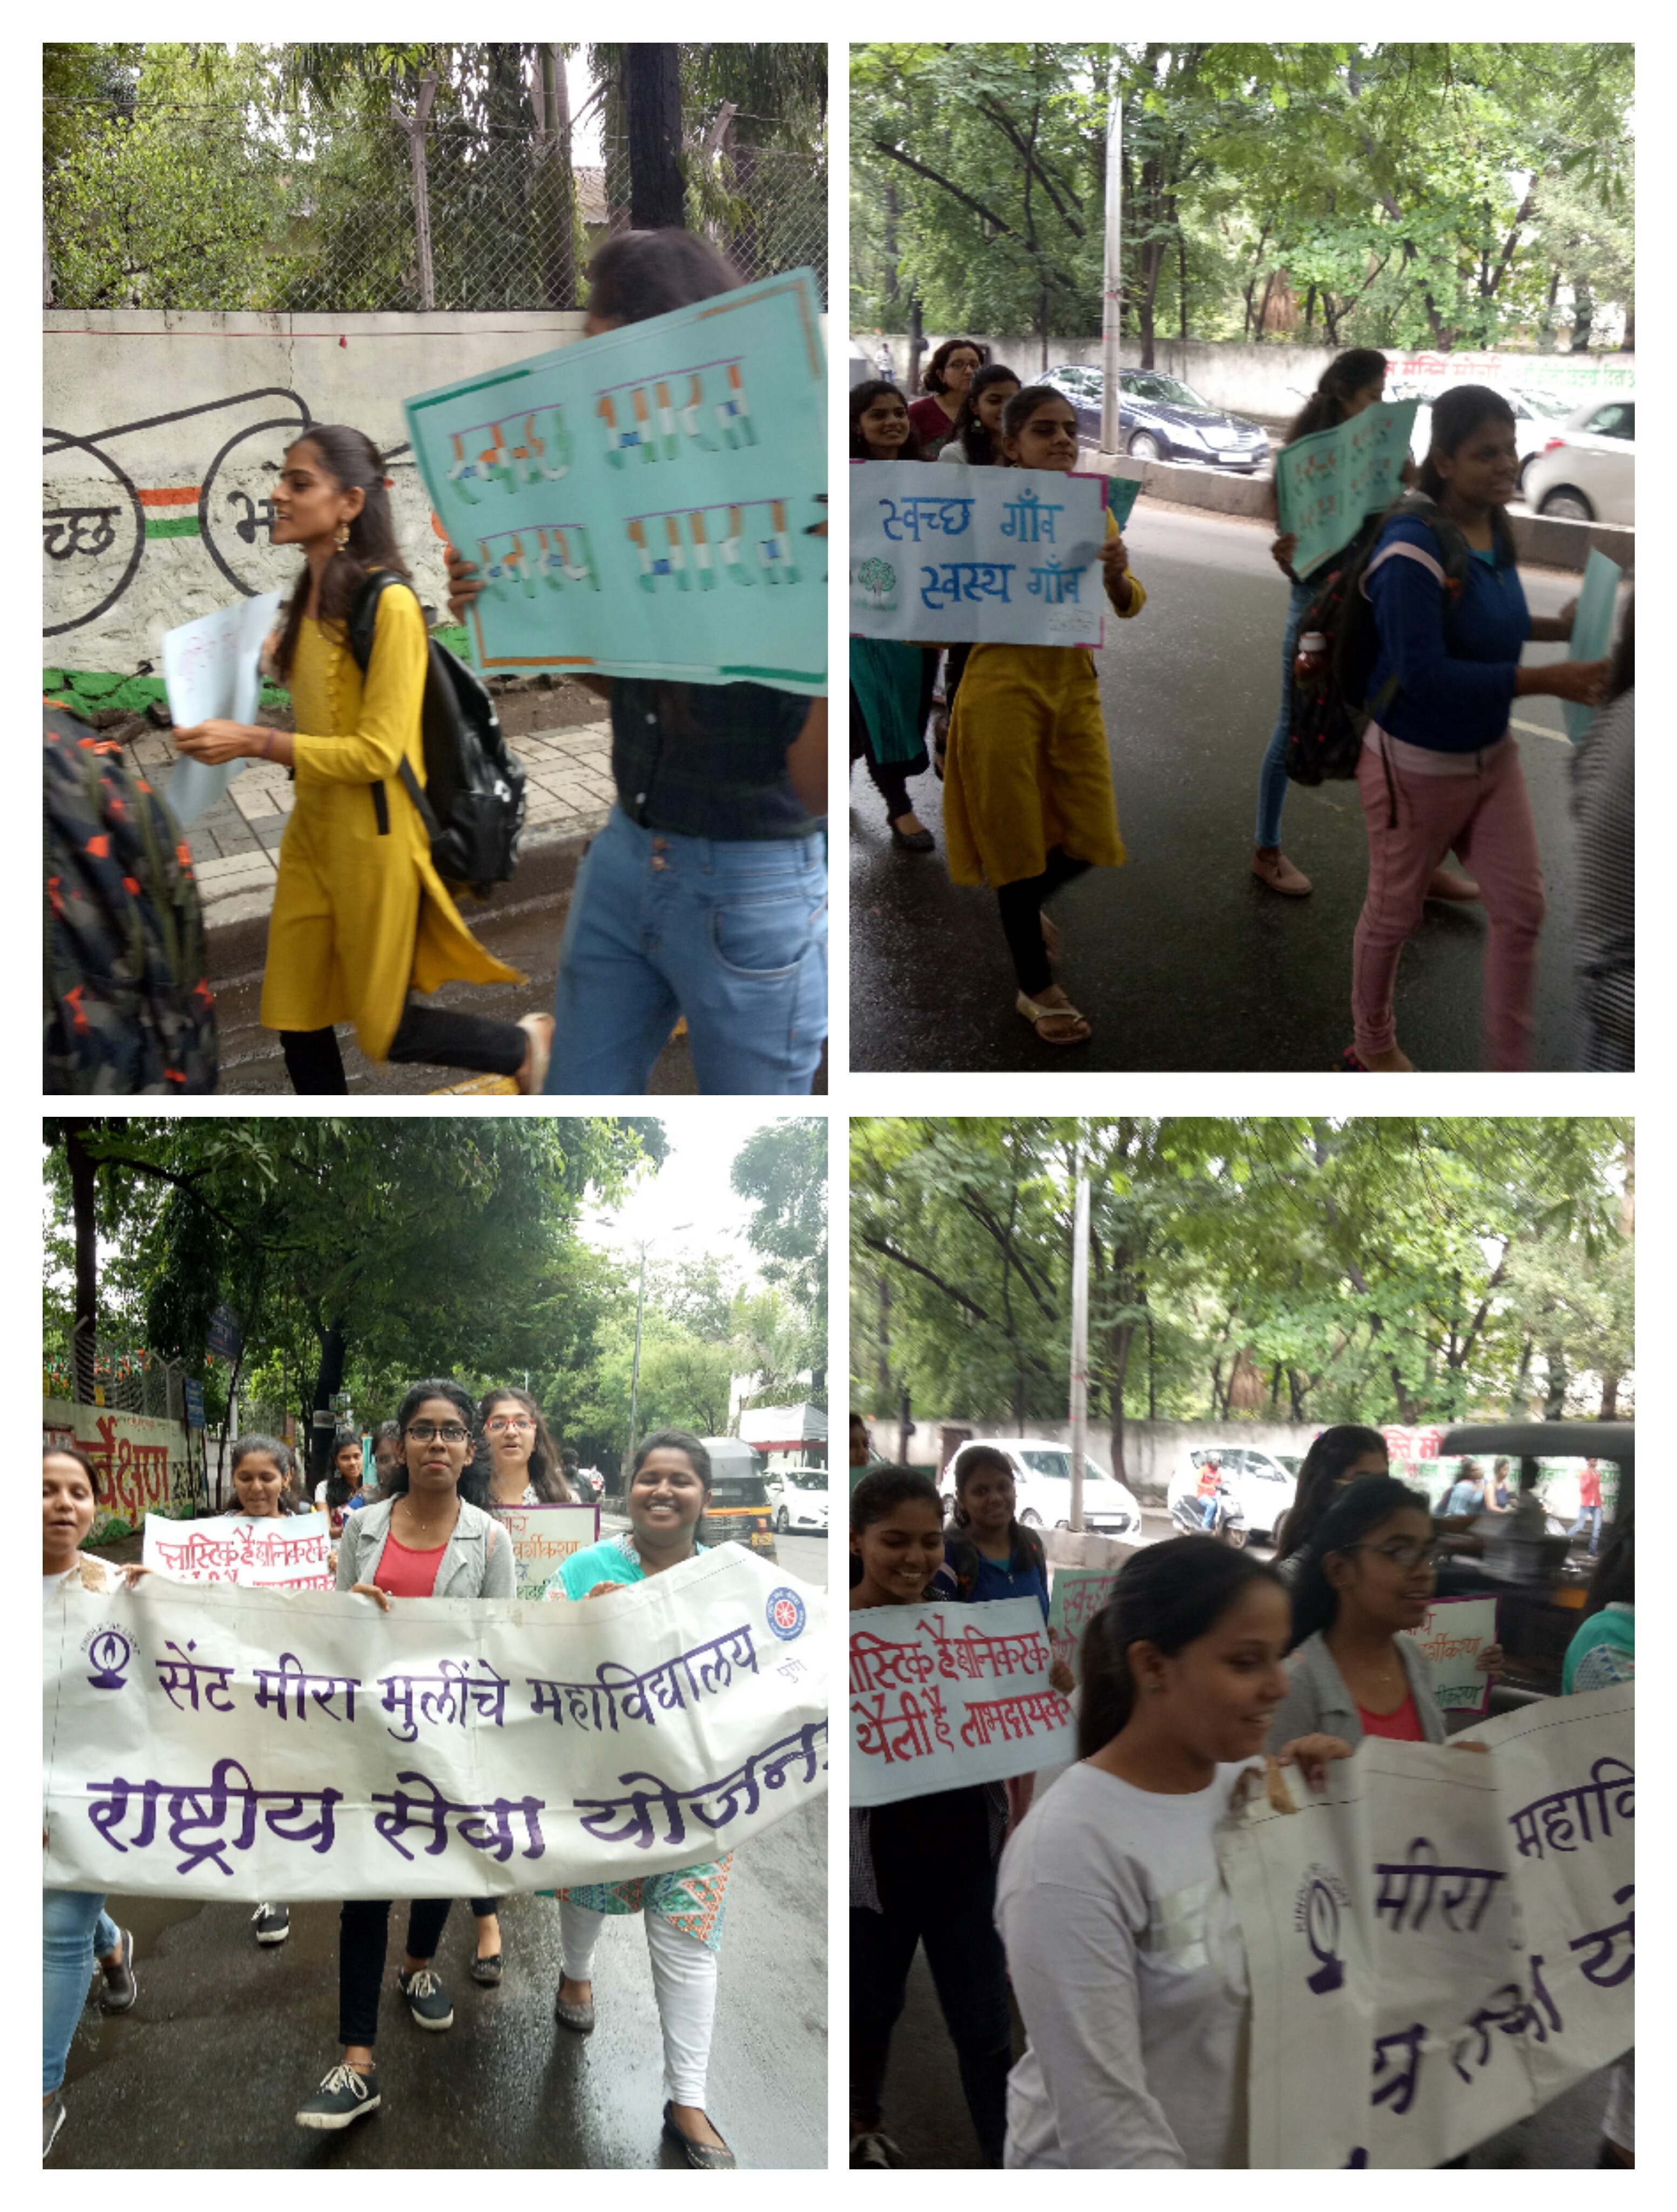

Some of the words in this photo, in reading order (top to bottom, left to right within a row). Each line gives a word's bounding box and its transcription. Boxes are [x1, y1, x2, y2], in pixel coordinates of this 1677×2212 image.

[594, 355, 756, 470] भारत
[624, 497, 802, 593] भारत
[880, 497, 975, 541] स्वच्छ
[992, 488, 1064, 543] गाँव
[919, 563, 1016, 610] स्वस्थ
[1025, 554, 1087, 604] गाँव
[76, 1415, 169, 1528] र्वेक्षण
[155, 1639, 235, 1711] सेंट
[253, 1652, 361, 1722] मीरा
[377, 1658, 510, 1743] मुलींचे
[525, 1624, 760, 1732] महाविद्यालय
[851, 1691, 935, 1764] थैली
[921, 1685, 955, 1752] है
[86, 1758, 343, 1875] राष्ट्रीय
[371, 1771, 545, 1862] सेवा
[573, 1716, 828, 1849] योजन
[1374, 1837, 1507, 1932] मीरा
